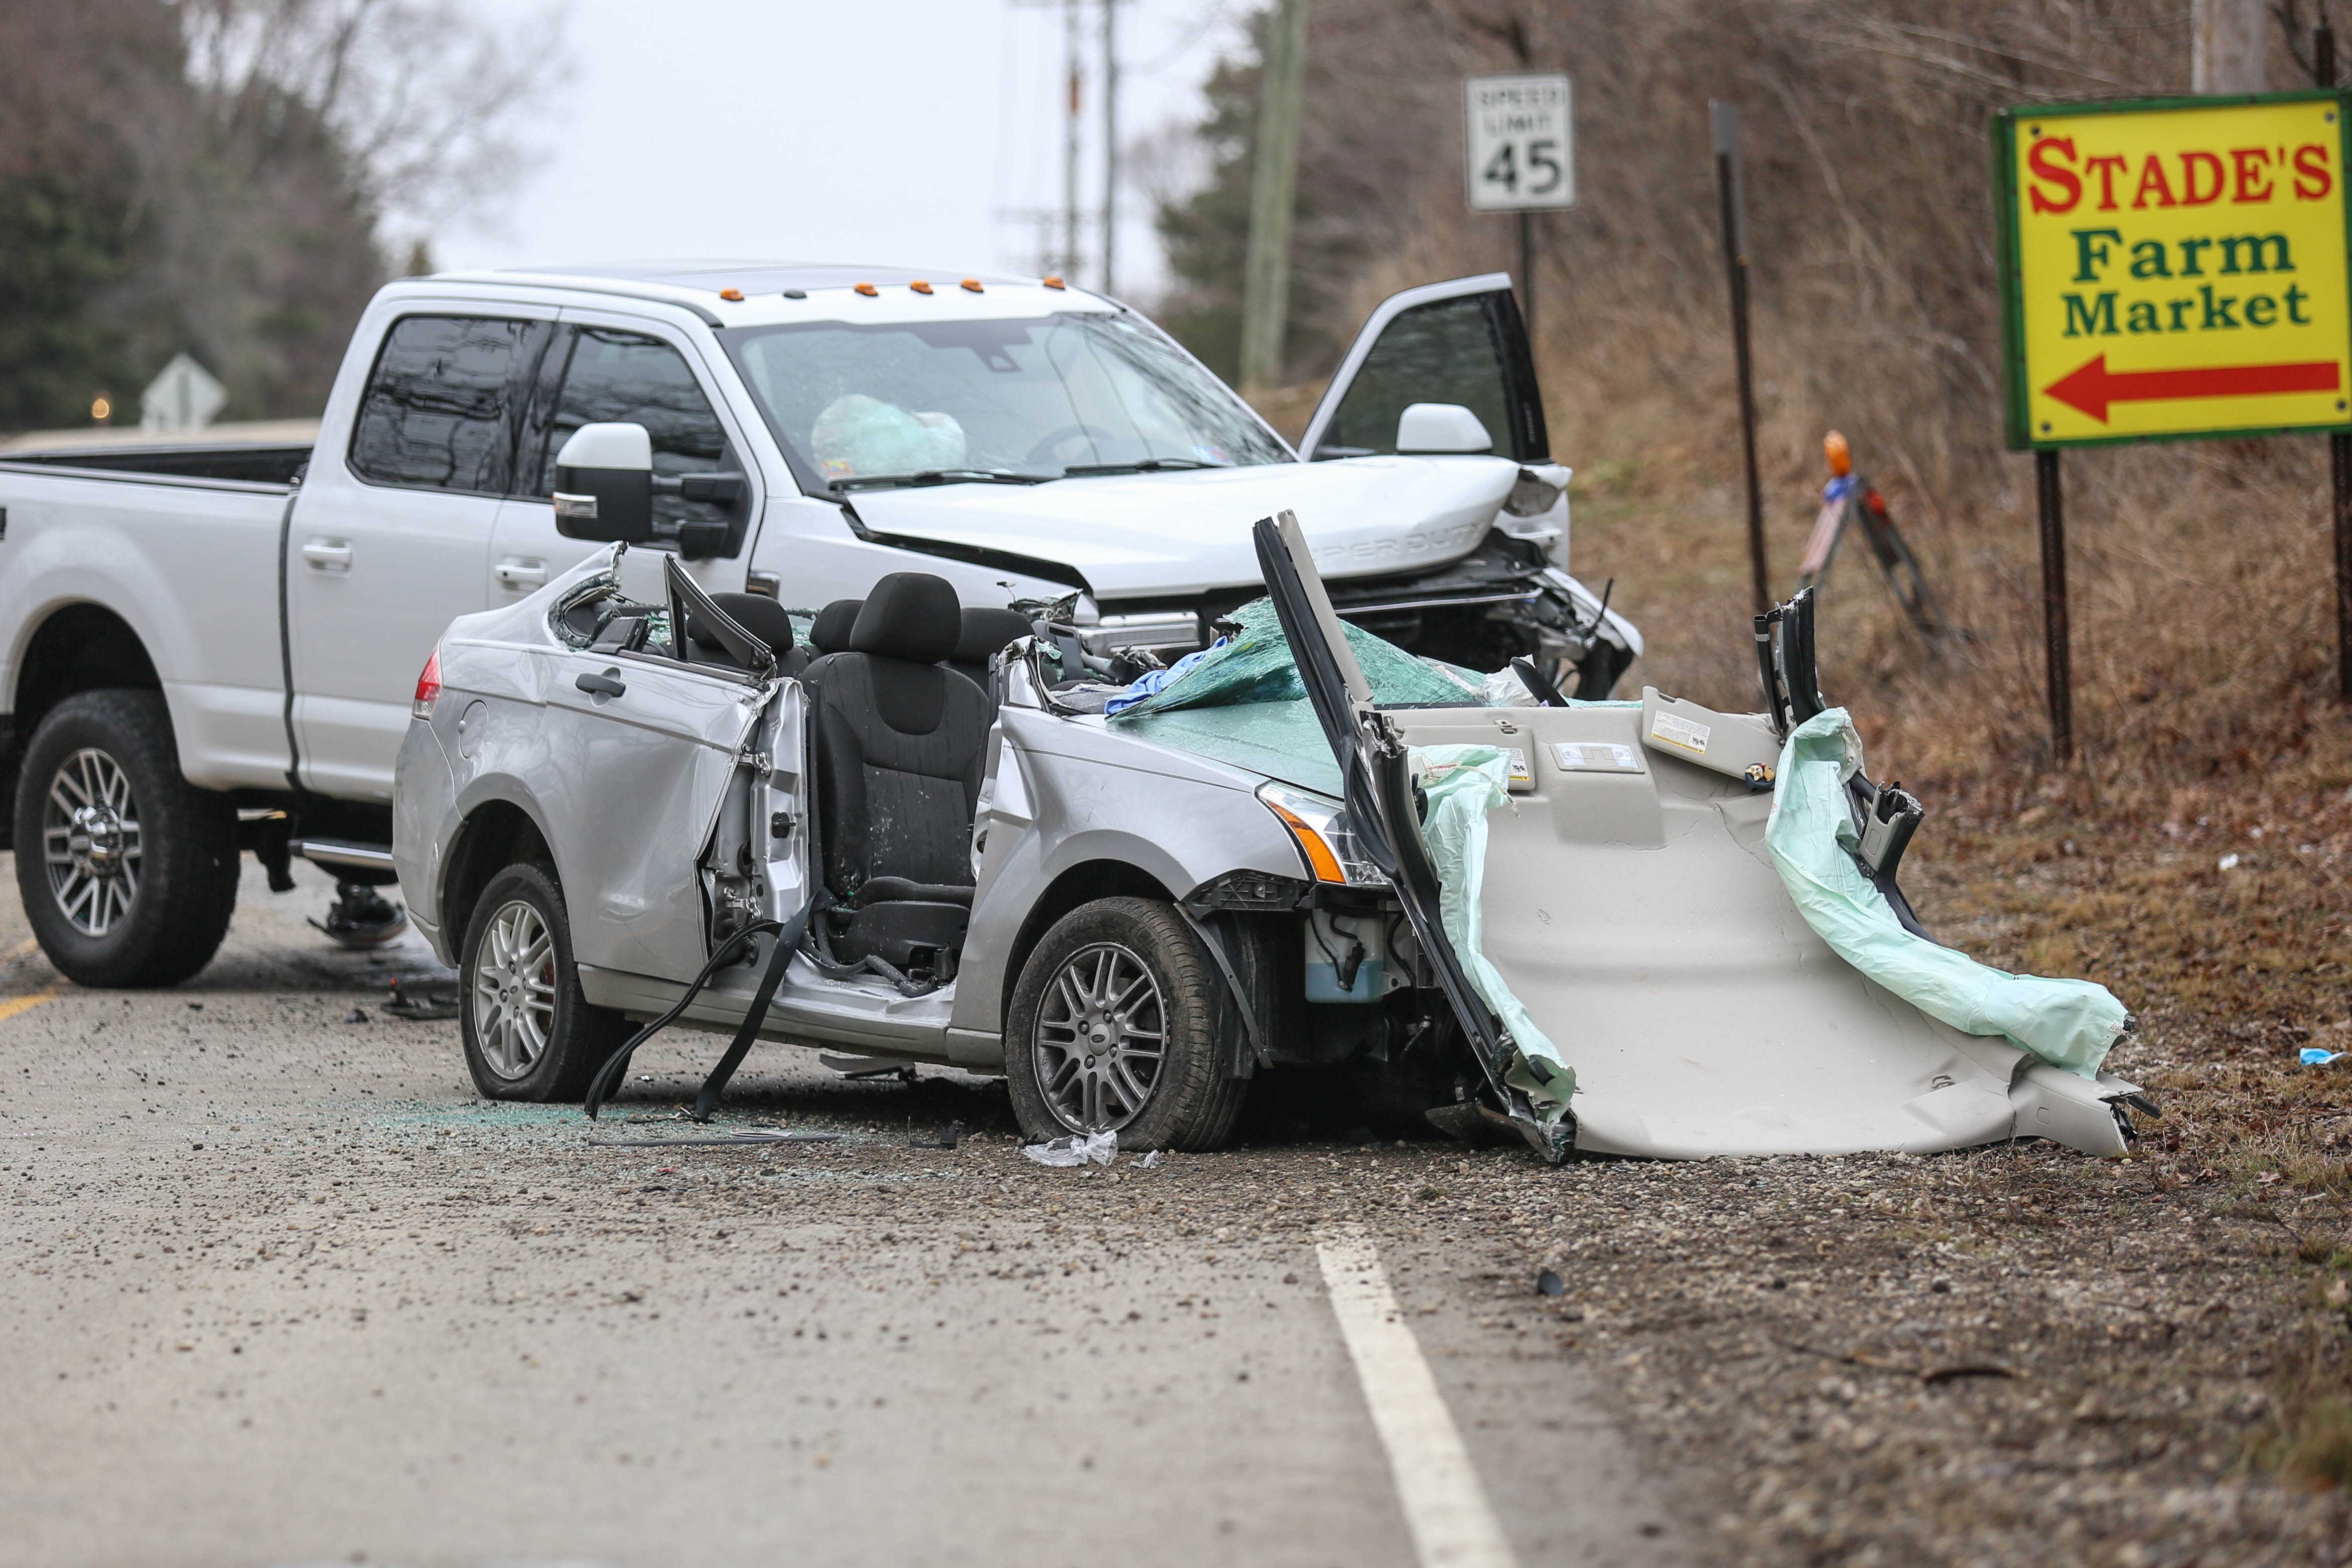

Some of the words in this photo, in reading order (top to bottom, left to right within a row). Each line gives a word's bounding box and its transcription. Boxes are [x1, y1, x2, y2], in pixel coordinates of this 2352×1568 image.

[1482, 140, 1562, 194] 45
[2027, 135, 2333, 216] STADE'S
[2070, 227, 2297, 283] Farm
[2061, 282, 2312, 338] Market
